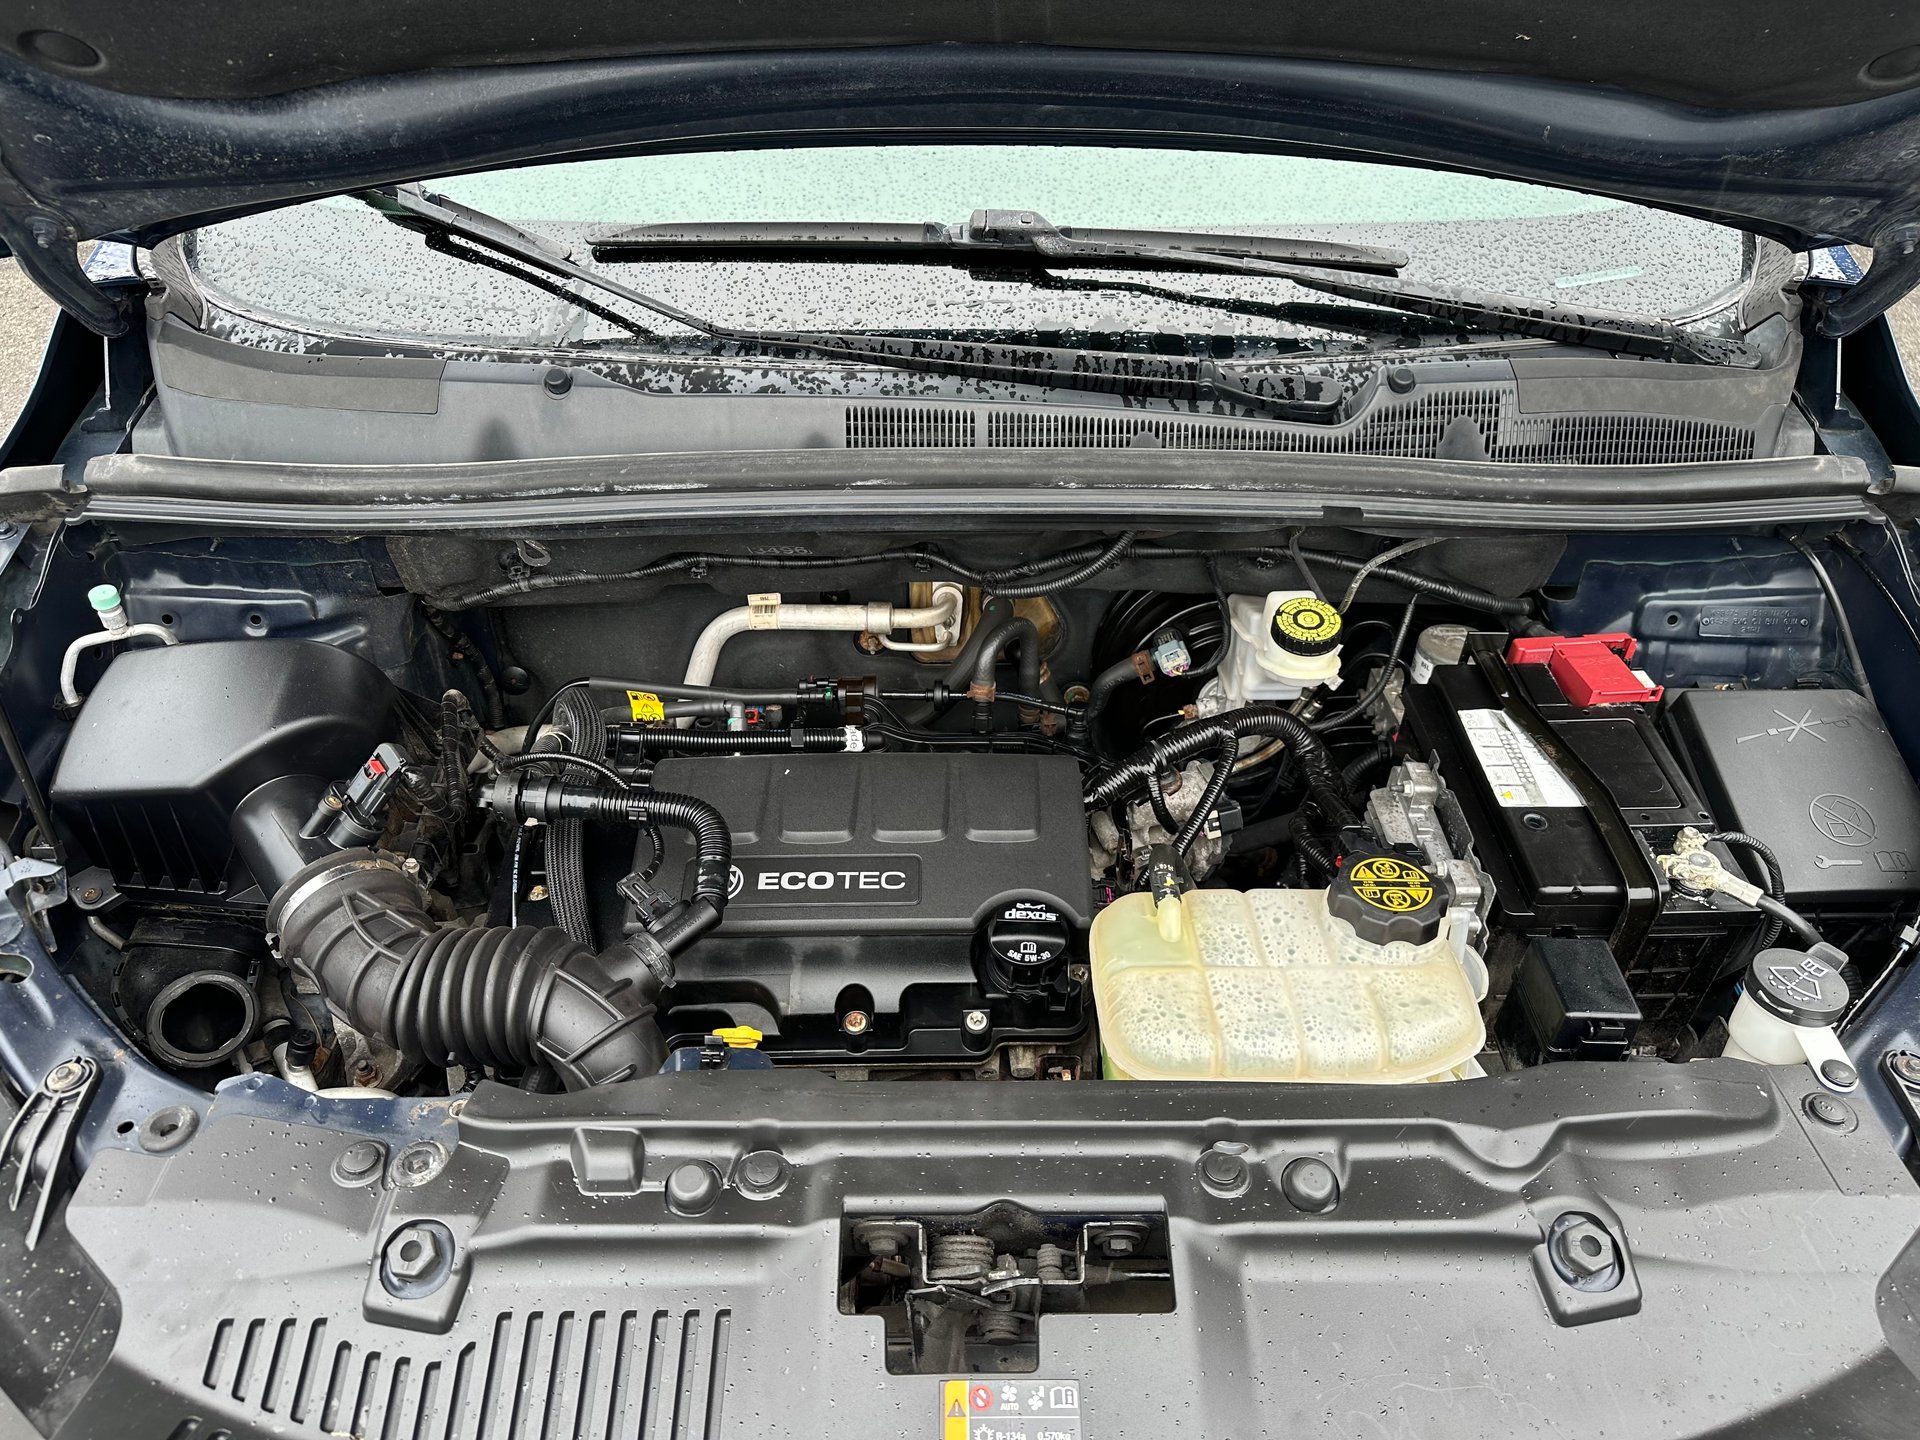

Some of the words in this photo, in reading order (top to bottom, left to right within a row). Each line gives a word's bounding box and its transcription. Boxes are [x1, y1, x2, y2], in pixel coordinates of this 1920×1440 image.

[757, 871, 906, 890] ECOTEC
[1004, 908, 1057, 921] dexos
[1007, 949, 1023, 961] SAE
[1024, 951, 1051, 962] 5W-30
[1000, 1402, 1019, 1411] AUTO
